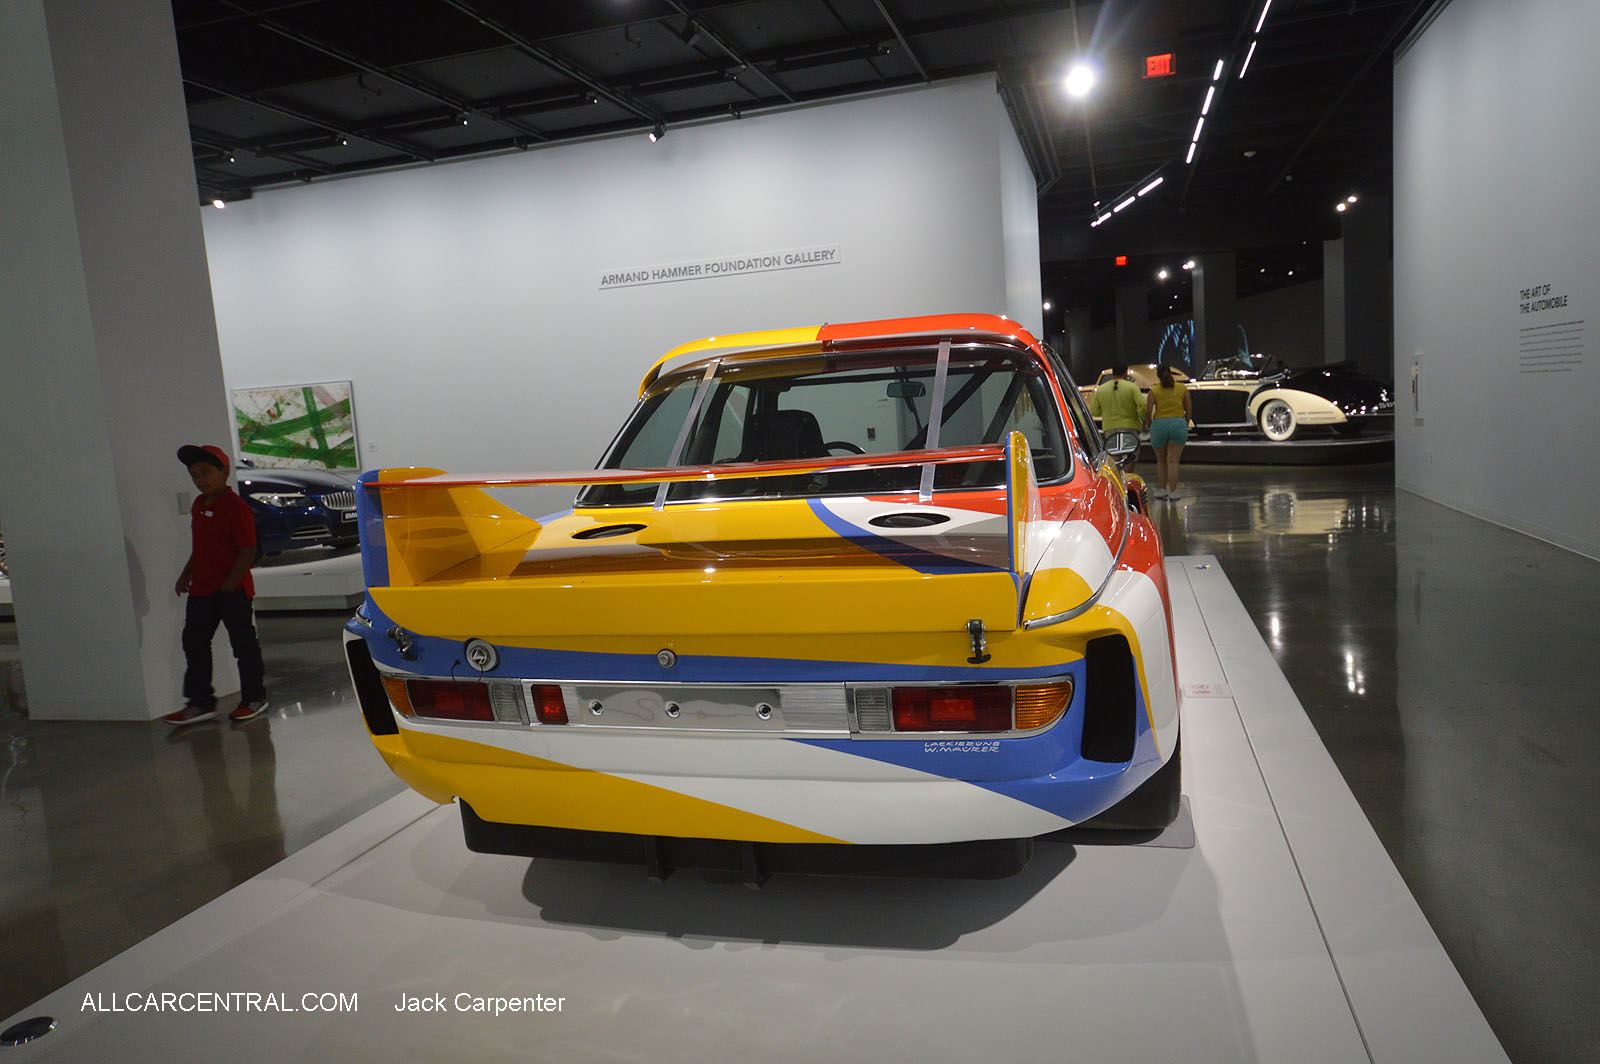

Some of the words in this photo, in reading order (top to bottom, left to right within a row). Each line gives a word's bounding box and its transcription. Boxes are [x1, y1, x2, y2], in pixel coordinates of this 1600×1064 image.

[1147, 54, 1171, 76] EXIT
[601, 271, 649, 286] ARMAND
[652, 265, 702, 281] HAMMER
[704, 256, 781, 274] FOUNDATION
[784, 249, 836, 265] GALLERY
[1520, 288, 1530, 300] THE
[1531, 285, 1542, 297] ART
[1542, 284, 1550, 296] OF
[1520, 303, 1530, 314] THE
[1531, 295, 1568, 312] AUTOMOBILE
